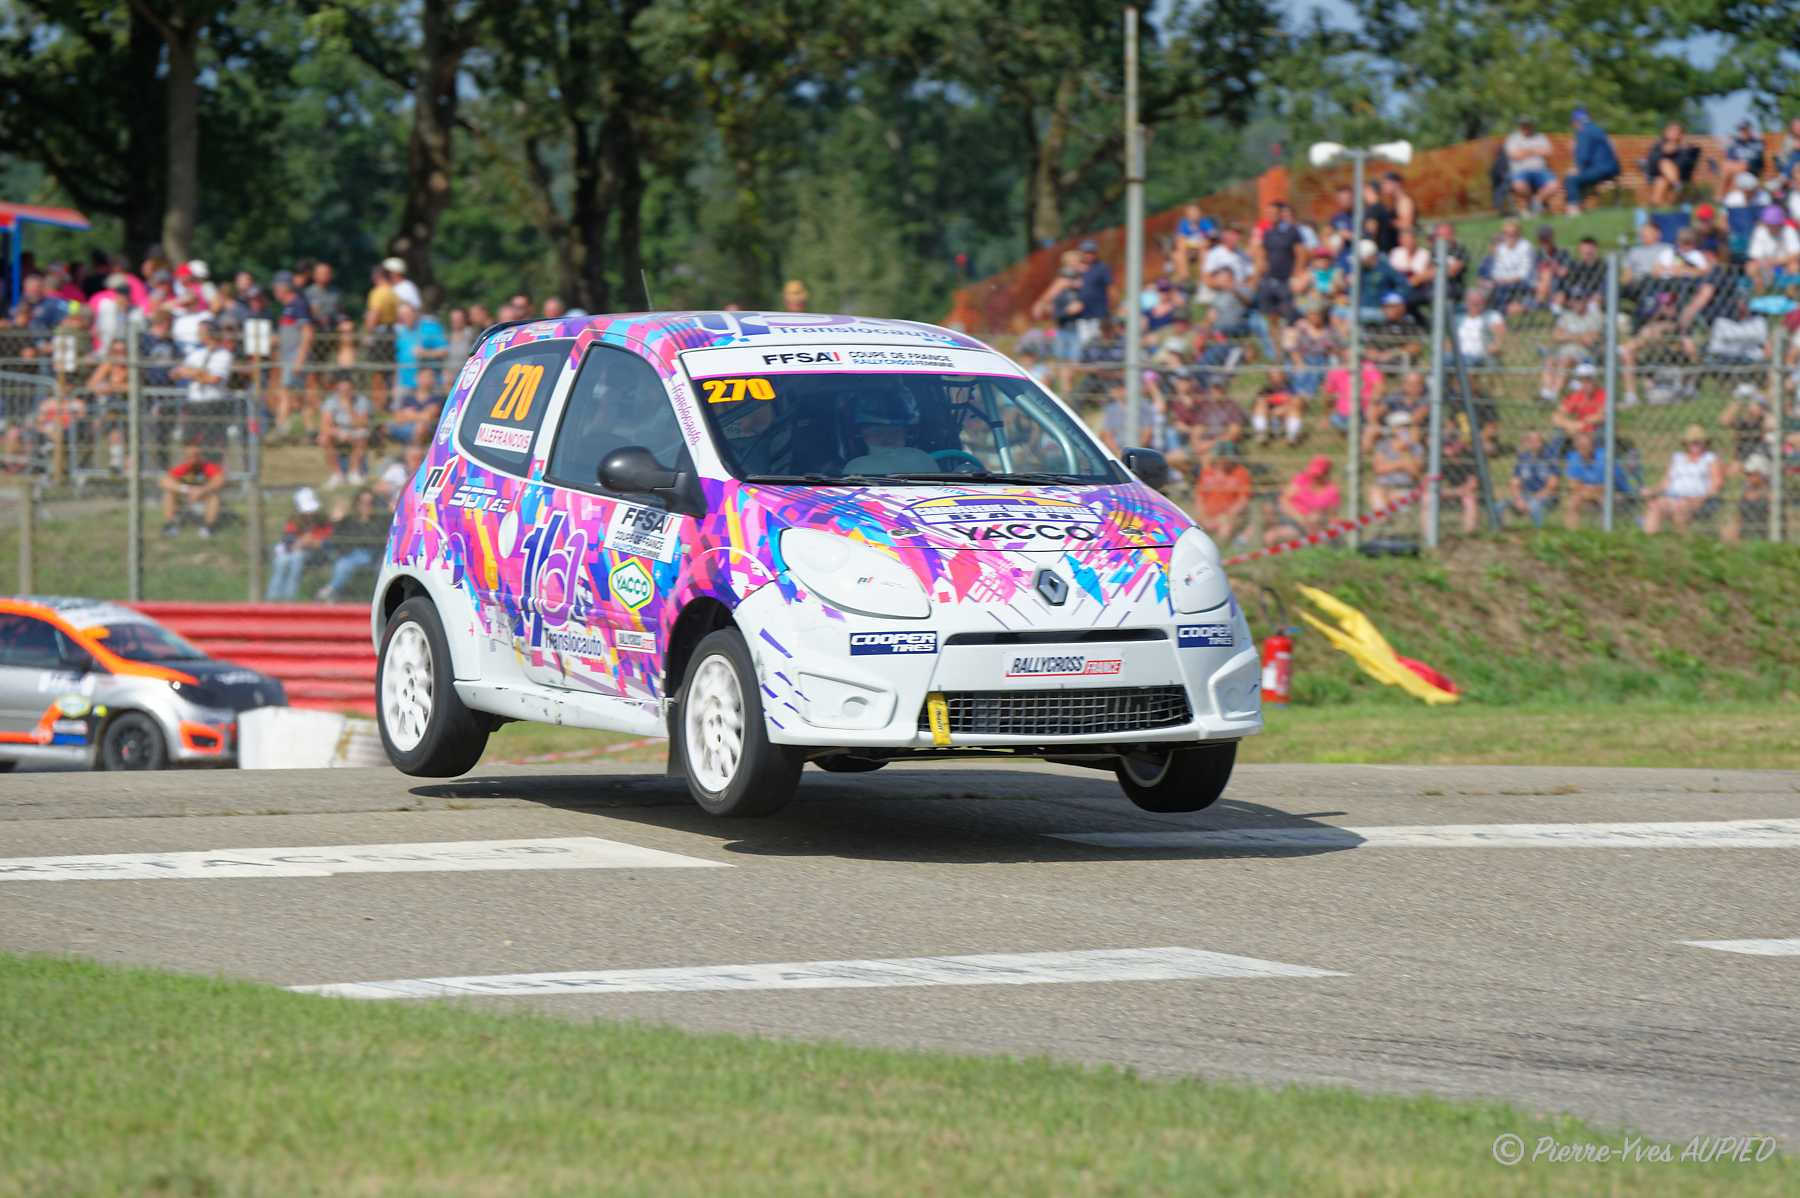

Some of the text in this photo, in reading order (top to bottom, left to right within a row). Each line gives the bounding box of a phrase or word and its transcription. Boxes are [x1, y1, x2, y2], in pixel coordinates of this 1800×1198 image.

[779, 326, 953, 341] Translocauto
[763, 352, 832, 366] FFSA
[489, 363, 545, 421] 270
[702, 378, 777, 404] 270
[621, 507, 666, 534] FFSA
[951, 523, 1096, 541] YACCO
[616, 575, 648, 597] YACCO
[544, 627, 601, 657] Translocauto
[851, 633, 936, 645] COOPER
[890, 643, 935, 652] TIRES
[1208, 636, 1232, 645] TIRES
[1011, 656, 1085, 673] RALLYCROSS
